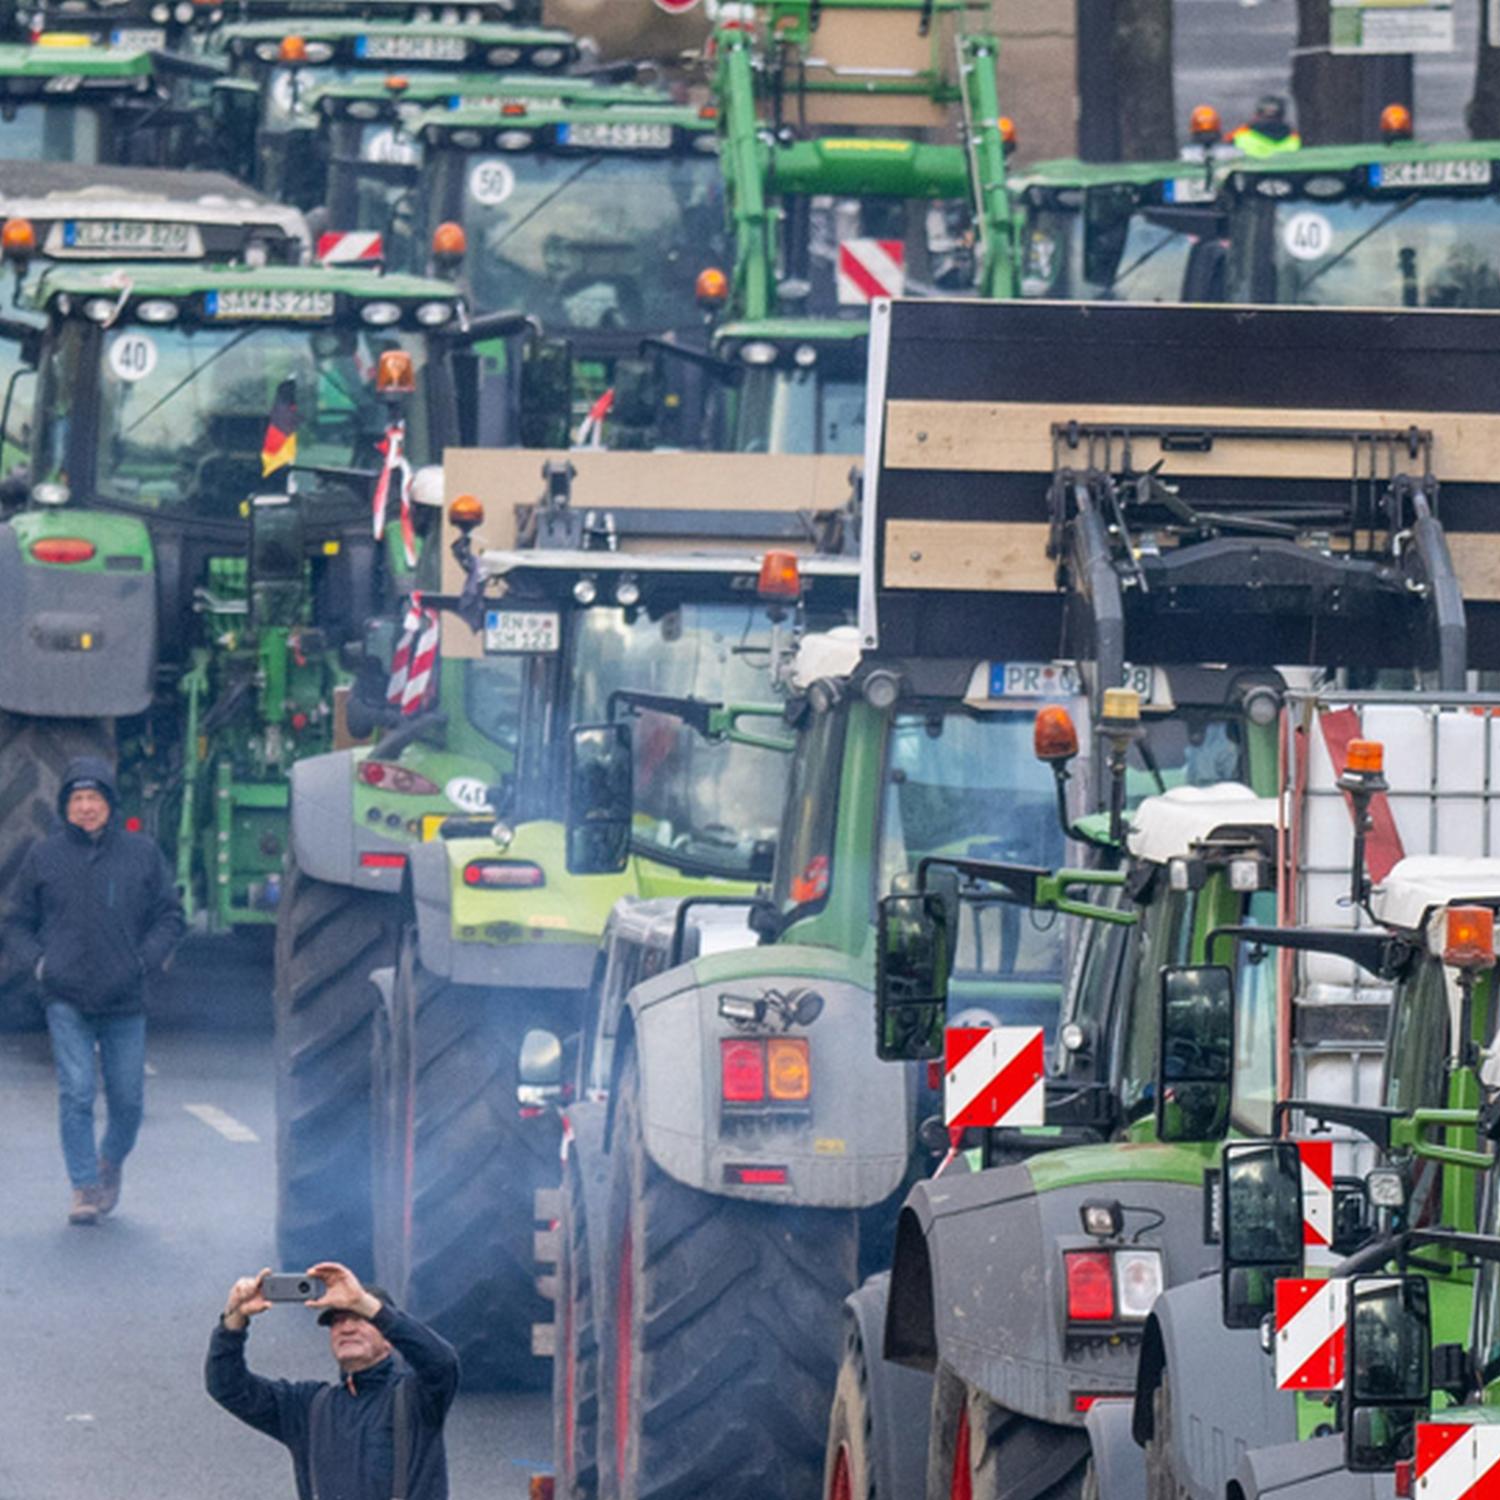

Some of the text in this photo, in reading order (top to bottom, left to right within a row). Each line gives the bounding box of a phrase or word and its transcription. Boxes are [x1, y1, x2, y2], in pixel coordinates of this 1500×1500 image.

[481, 168, 503, 194] 50
[119, 342, 147, 371] 40
[1007, 667, 1040, 691] PR
